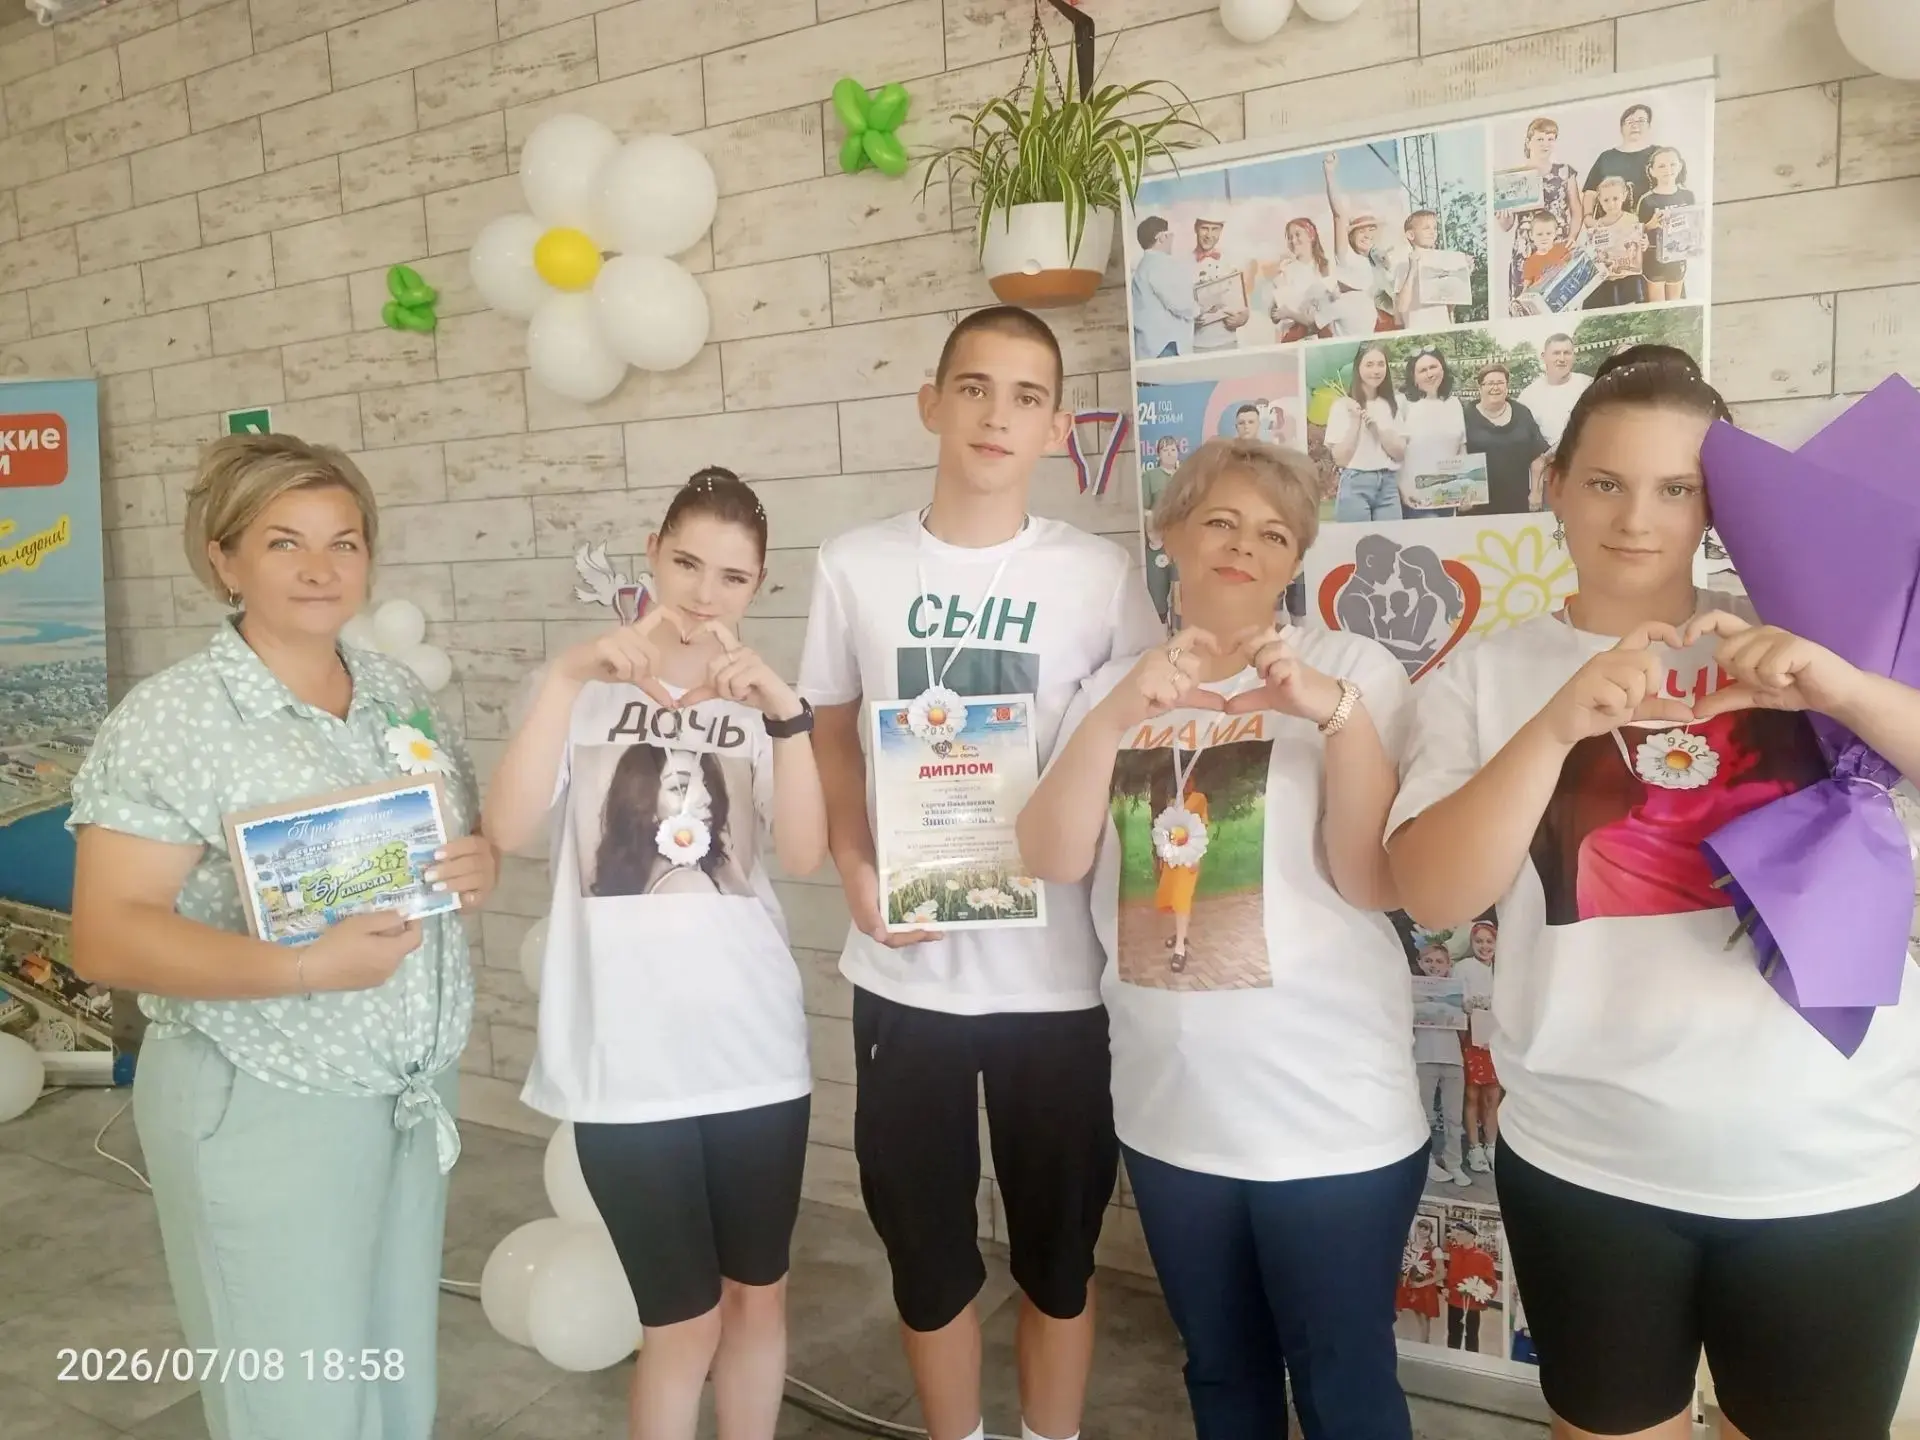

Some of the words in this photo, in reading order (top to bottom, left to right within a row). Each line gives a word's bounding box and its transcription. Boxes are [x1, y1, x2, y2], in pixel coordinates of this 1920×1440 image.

[0, 427, 61, 452] кие
[11, 520, 66, 567] ладони!
[907, 593, 1037, 644] СЫН
[607, 701, 746, 748] ДОЧЬ
[1131, 714, 1264, 749] МАМА
[1667, 736, 1709, 760] 2026
[918, 762, 994, 779] ДИПЛОМ
